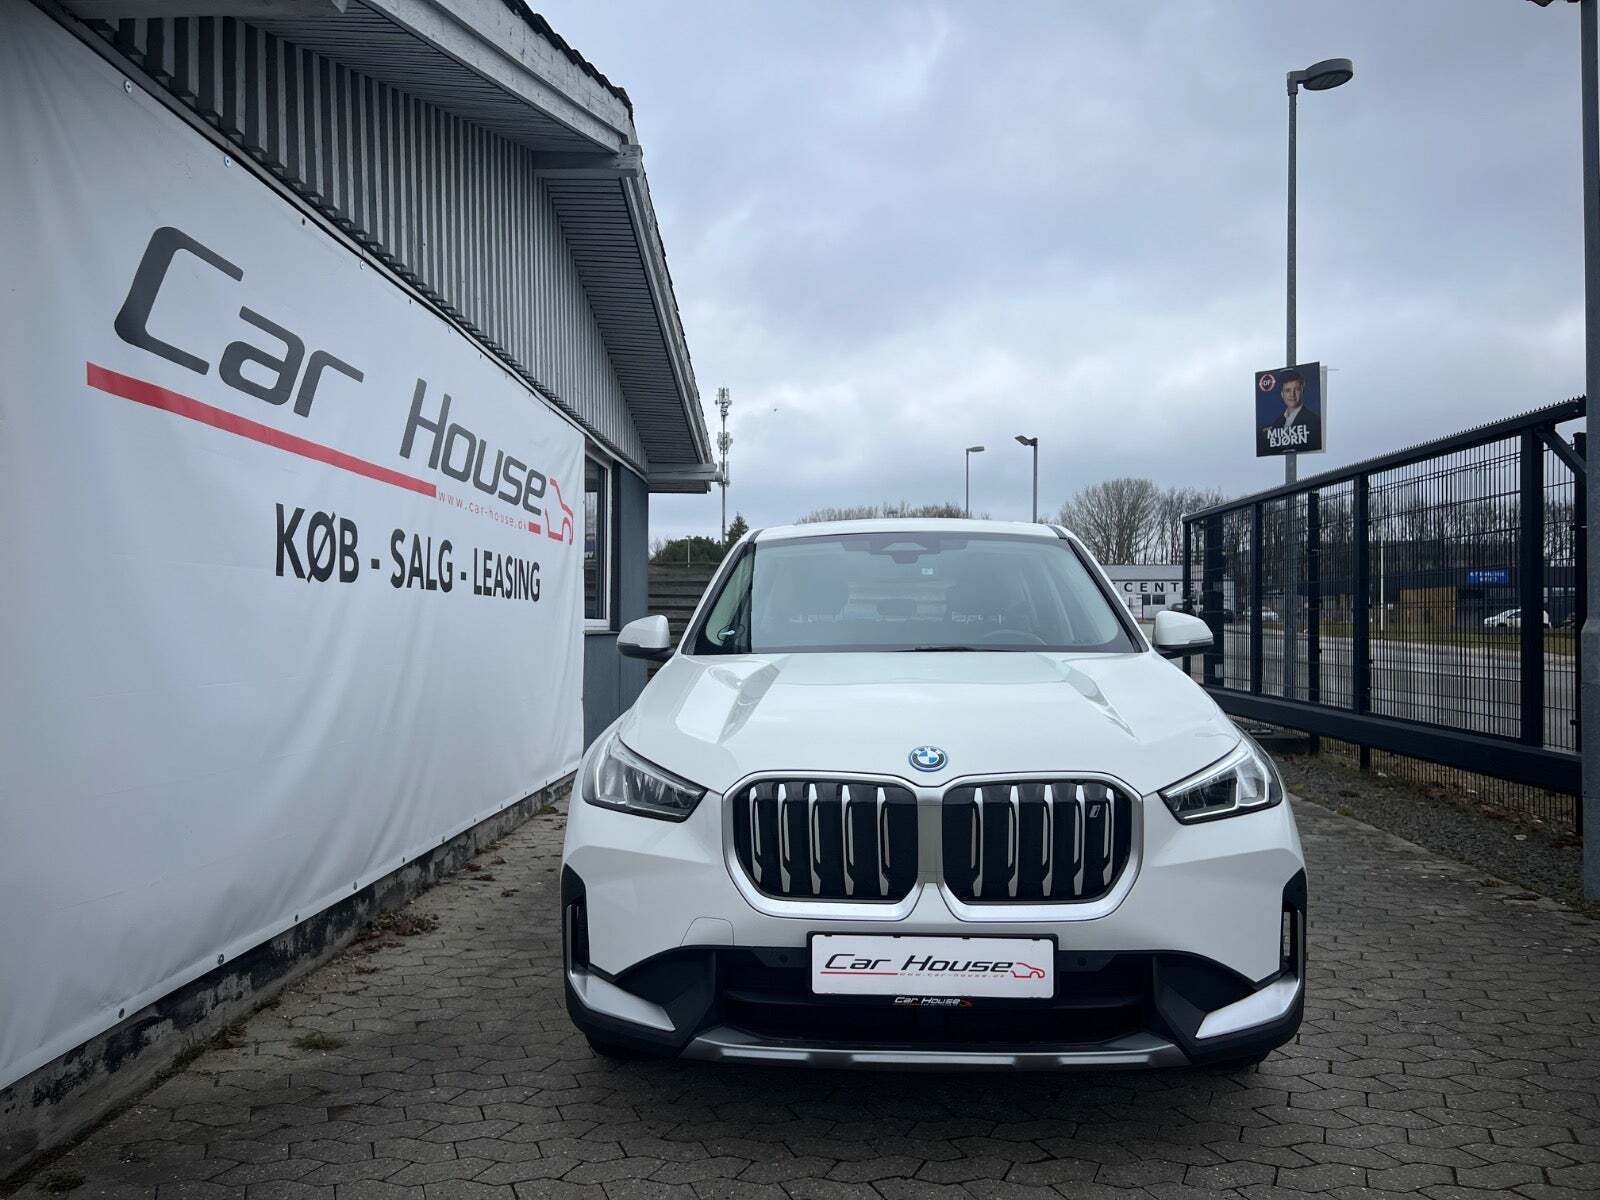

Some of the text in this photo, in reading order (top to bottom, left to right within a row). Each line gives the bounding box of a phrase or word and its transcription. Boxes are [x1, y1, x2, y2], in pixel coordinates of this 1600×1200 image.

[114, 226, 547, 516] Car House
[1267, 424, 1310, 440] MIKKEL
[1270, 432, 1308, 447] BJØRN
[275, 503, 541, 602] KØB - SALG - LEASING
[1124, 583, 1195, 592] CENTE
[825, 953, 1014, 972] Car House
